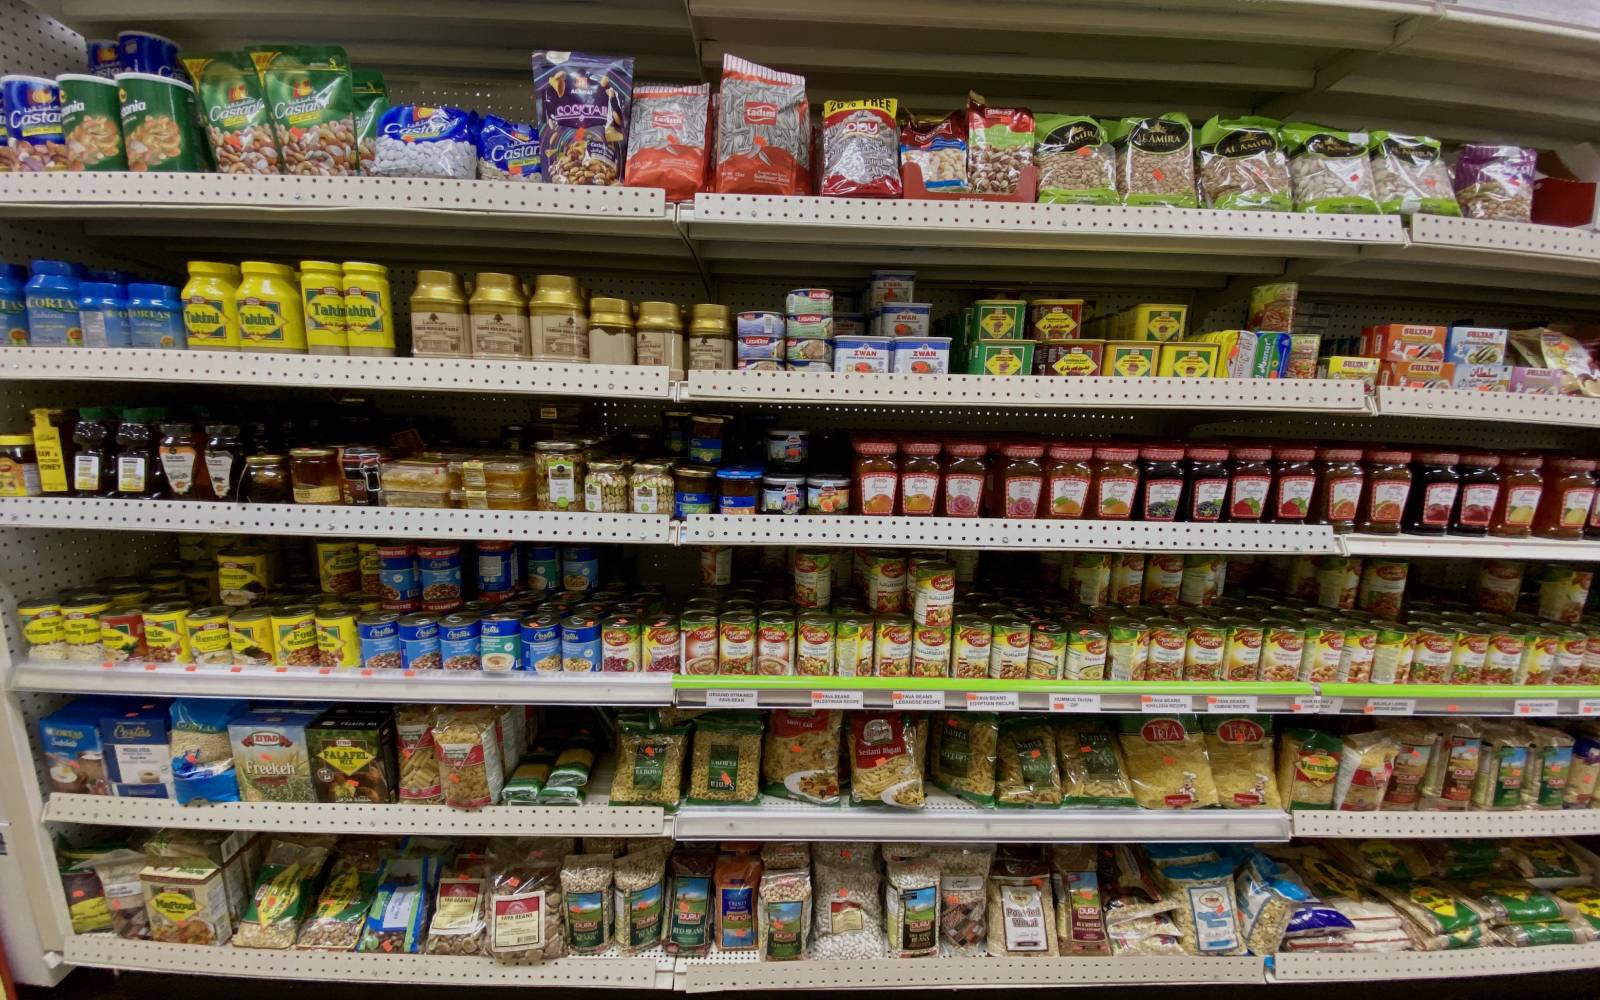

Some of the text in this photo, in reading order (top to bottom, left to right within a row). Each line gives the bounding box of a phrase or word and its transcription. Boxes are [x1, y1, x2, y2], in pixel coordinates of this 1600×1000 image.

[830, 98, 892, 112] 20% FREE
[1150, 133, 1182, 144] AMIRA
[26, 296, 78, 310] CORTA
[312, 302, 346, 318] Tahin
[347, 303, 376, 318] ahini
[854, 350, 877, 358] ZWAN
[912, 350, 937, 358] ZWAN
[113, 724, 152, 739] Cortas
[254, 734, 279, 742] ZIYAD
[323, 751, 368, 760] FALAFEL
[246, 760, 296, 776] Freekeh
